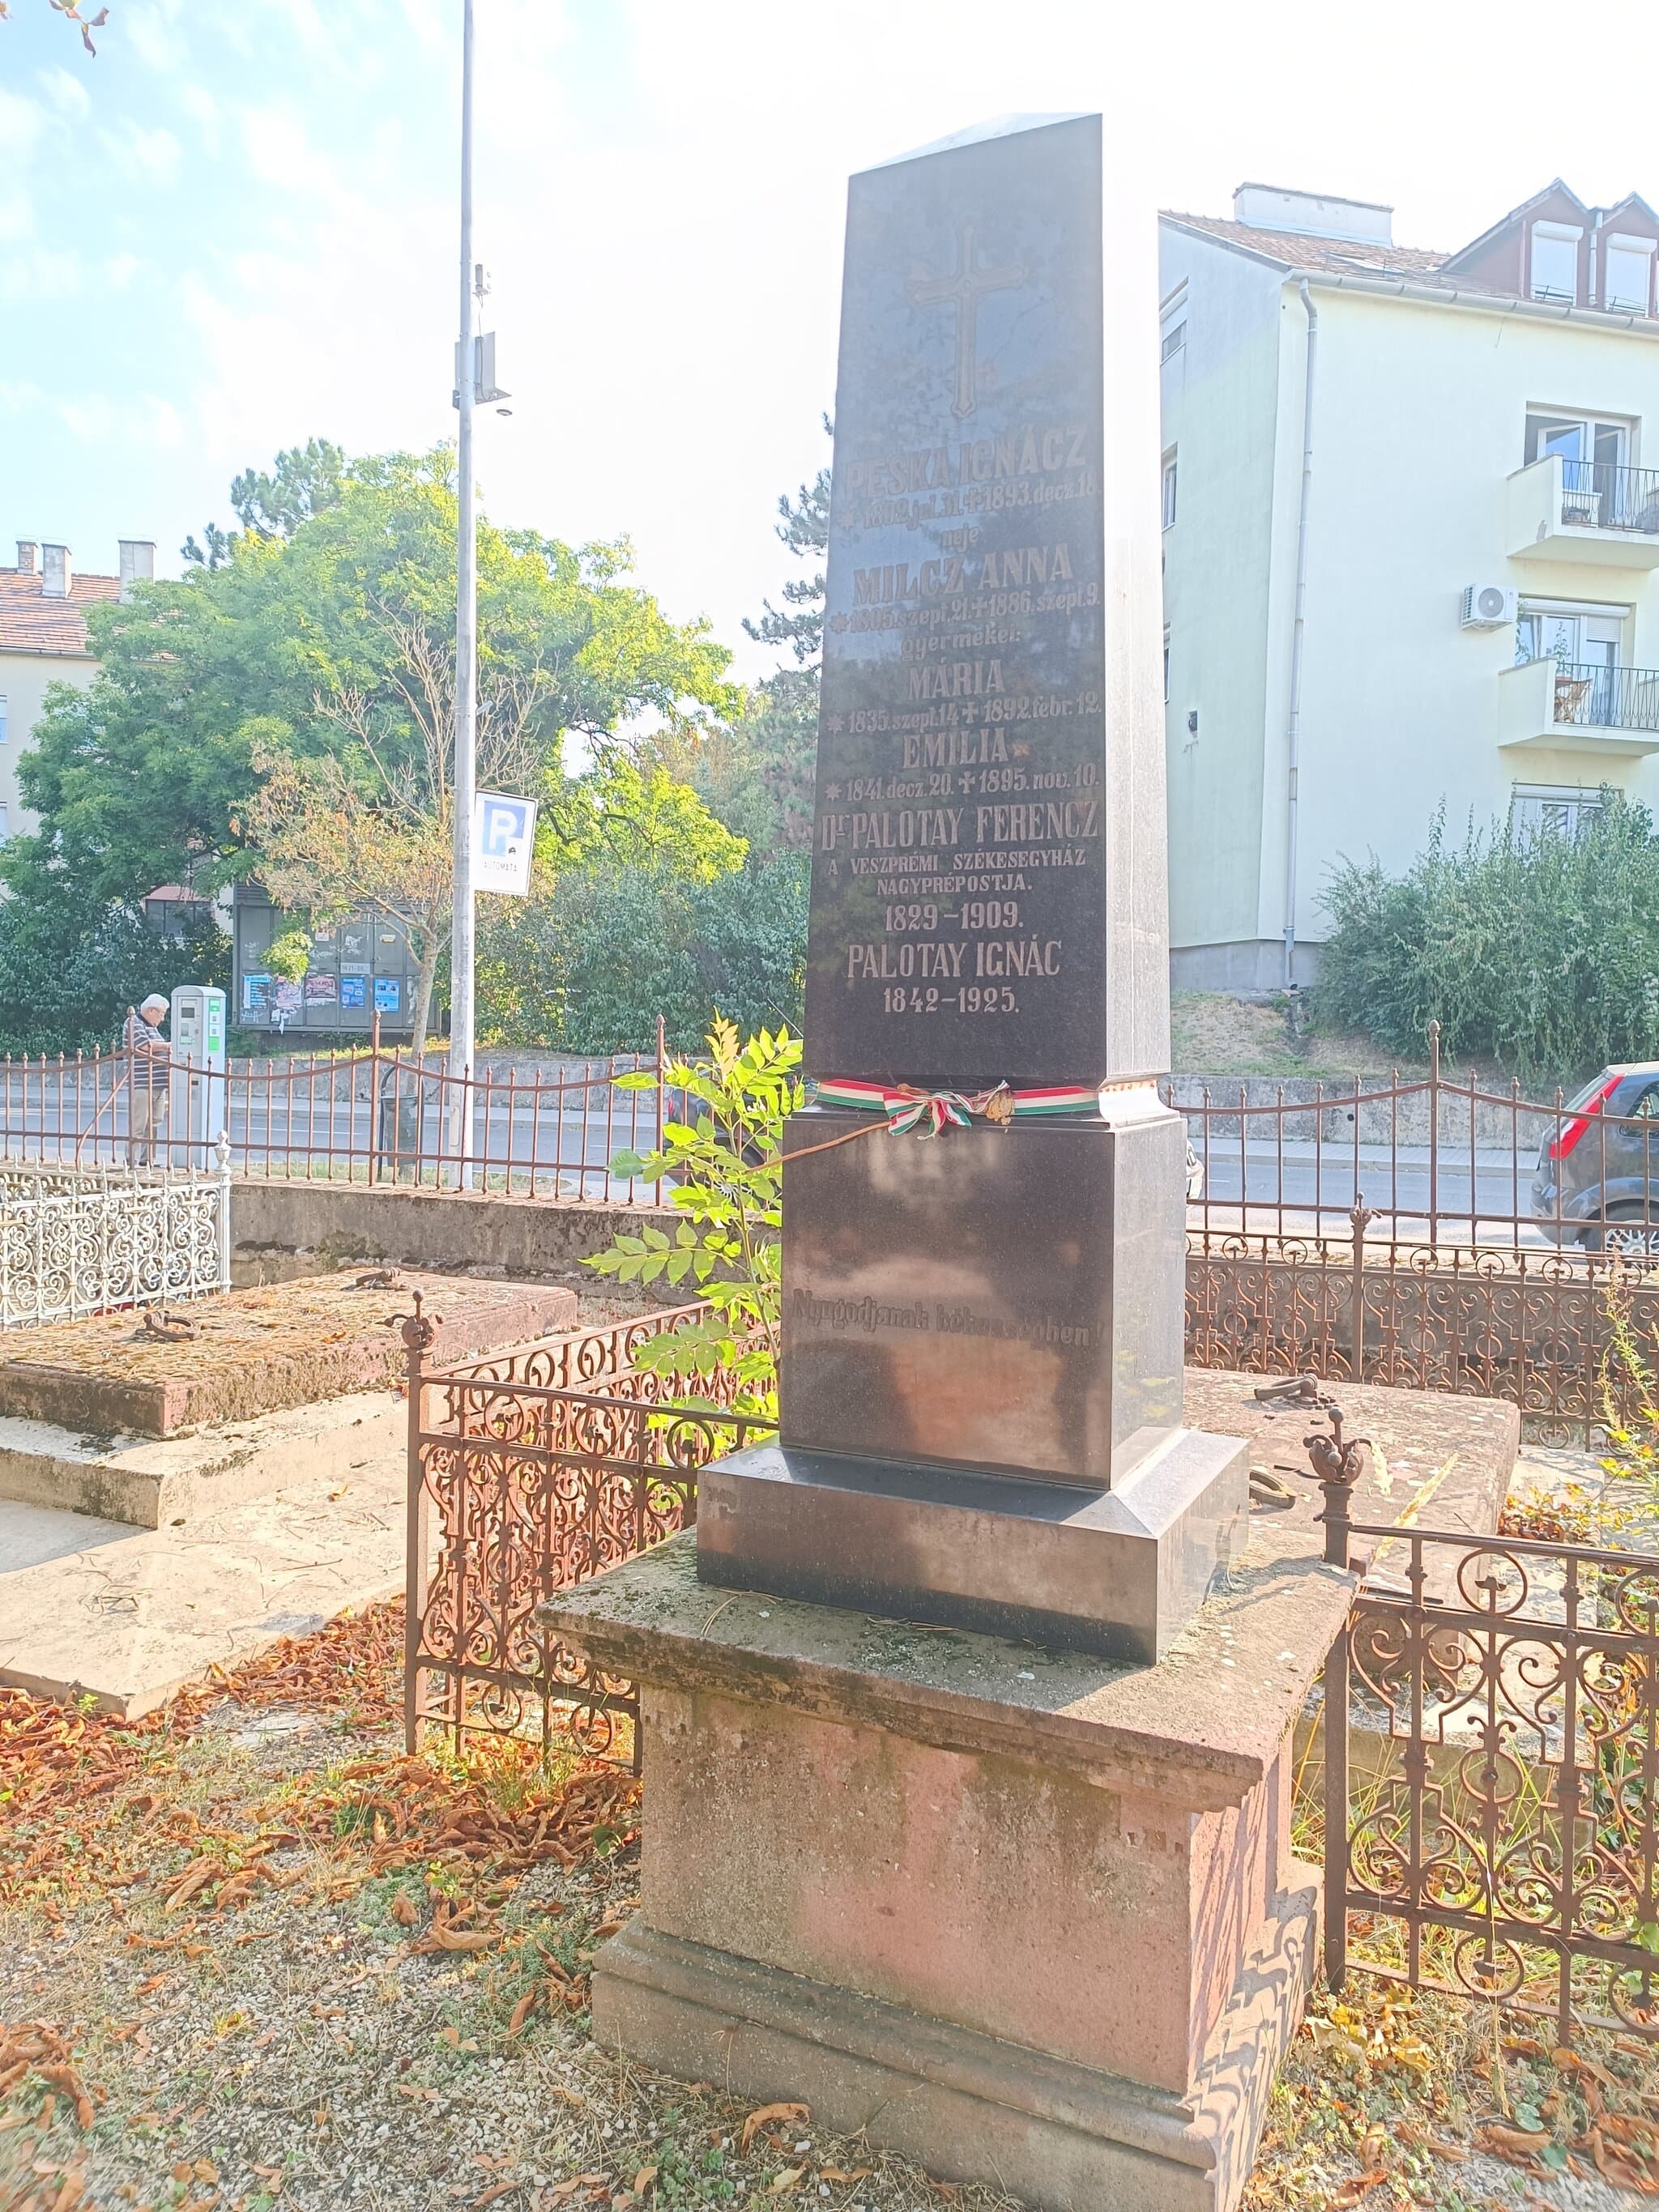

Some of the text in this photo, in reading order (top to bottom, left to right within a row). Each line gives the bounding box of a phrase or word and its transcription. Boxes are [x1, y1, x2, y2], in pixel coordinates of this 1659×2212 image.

[853, 543, 1073, 605] MILCZ ANNA
[907, 657, 1005, 700] MÁRIA
[903, 727, 1009, 769] EMILIA
[489, 809, 517, 850] P
[852, 808, 966, 850] PALOTAY
[976, 801, 1099, 843] FERENCZ
[828, 843, 1086, 876] A VESZPRÉMI SZÉKESEGYHÁZ
[847, 934, 1062, 978] PALOTAY IGNÁC
